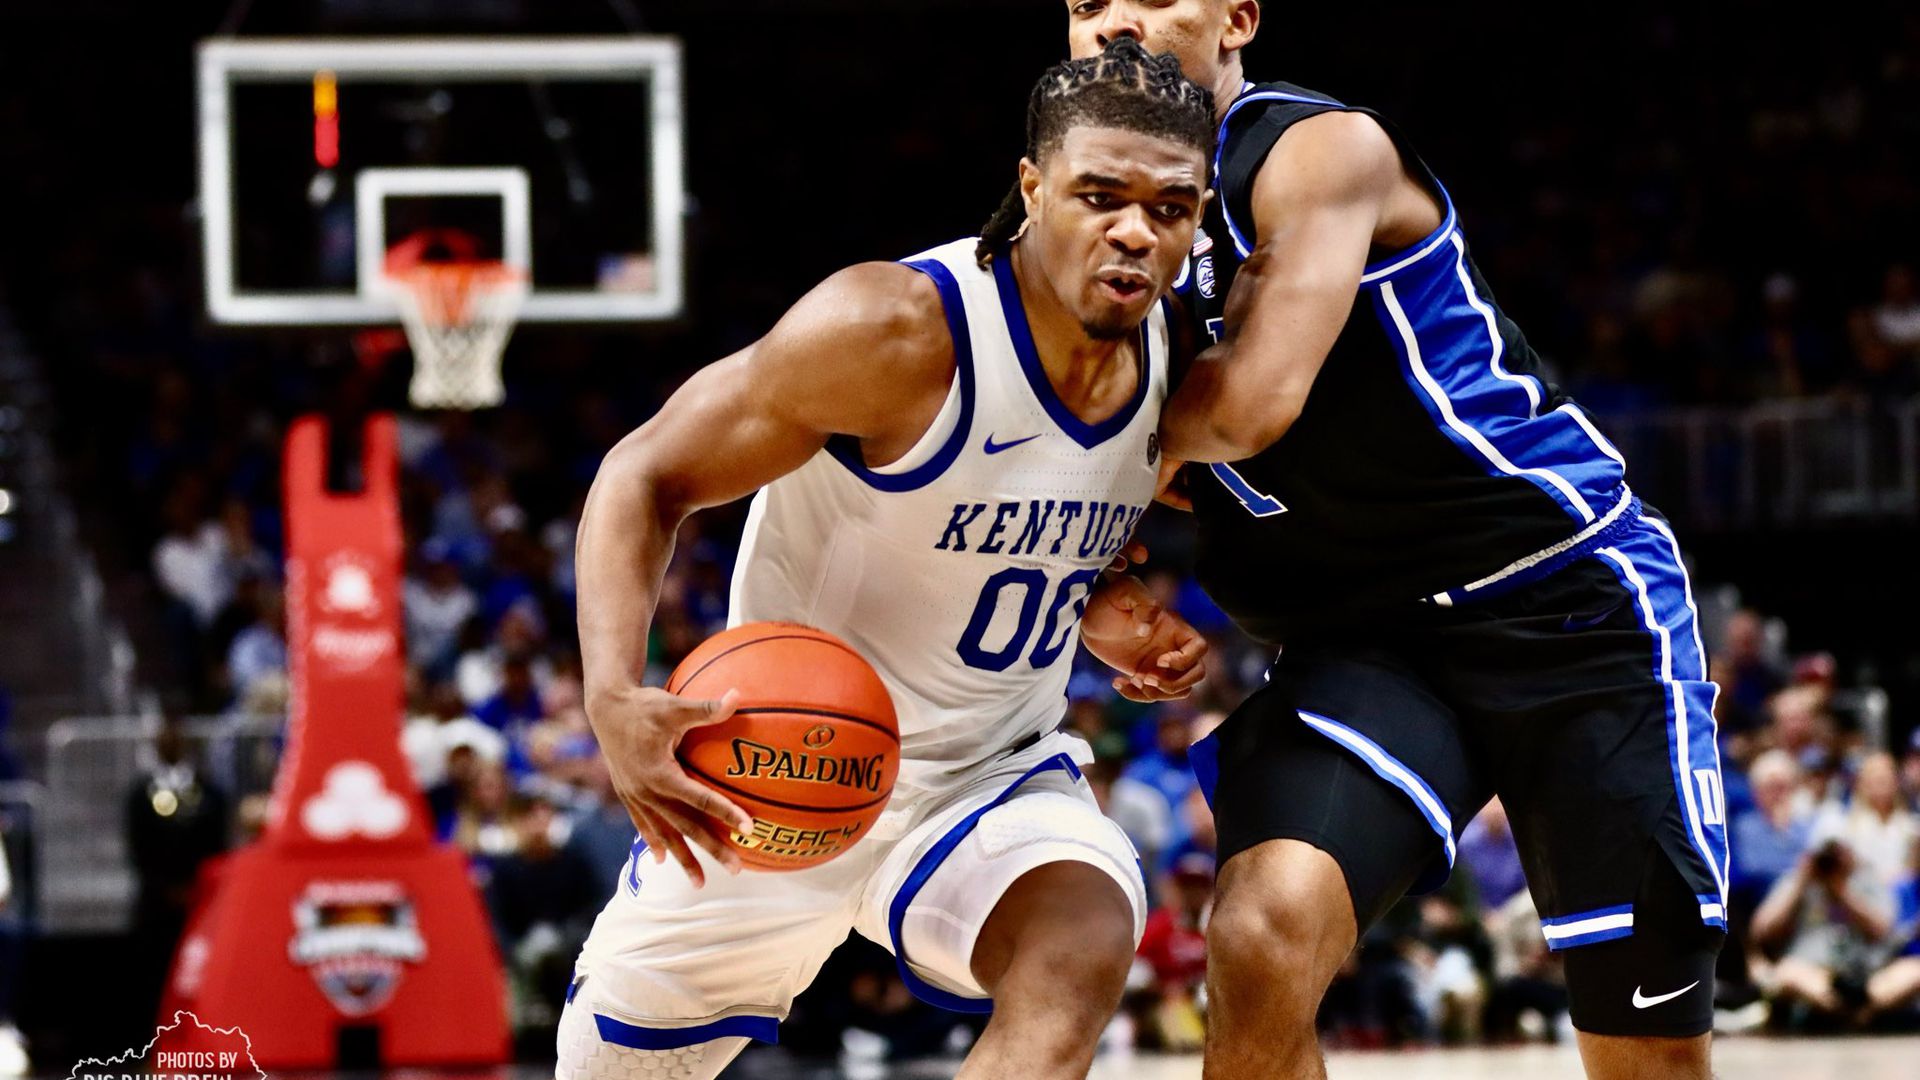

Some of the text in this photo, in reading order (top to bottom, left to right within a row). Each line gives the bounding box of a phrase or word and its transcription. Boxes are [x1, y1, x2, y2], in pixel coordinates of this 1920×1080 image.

[934, 500, 1144, 558] KENTUCK
[956, 566, 1100, 673] 00
[726, 737, 885, 793] SPALDING
[751, 816, 862, 847] EGACY
